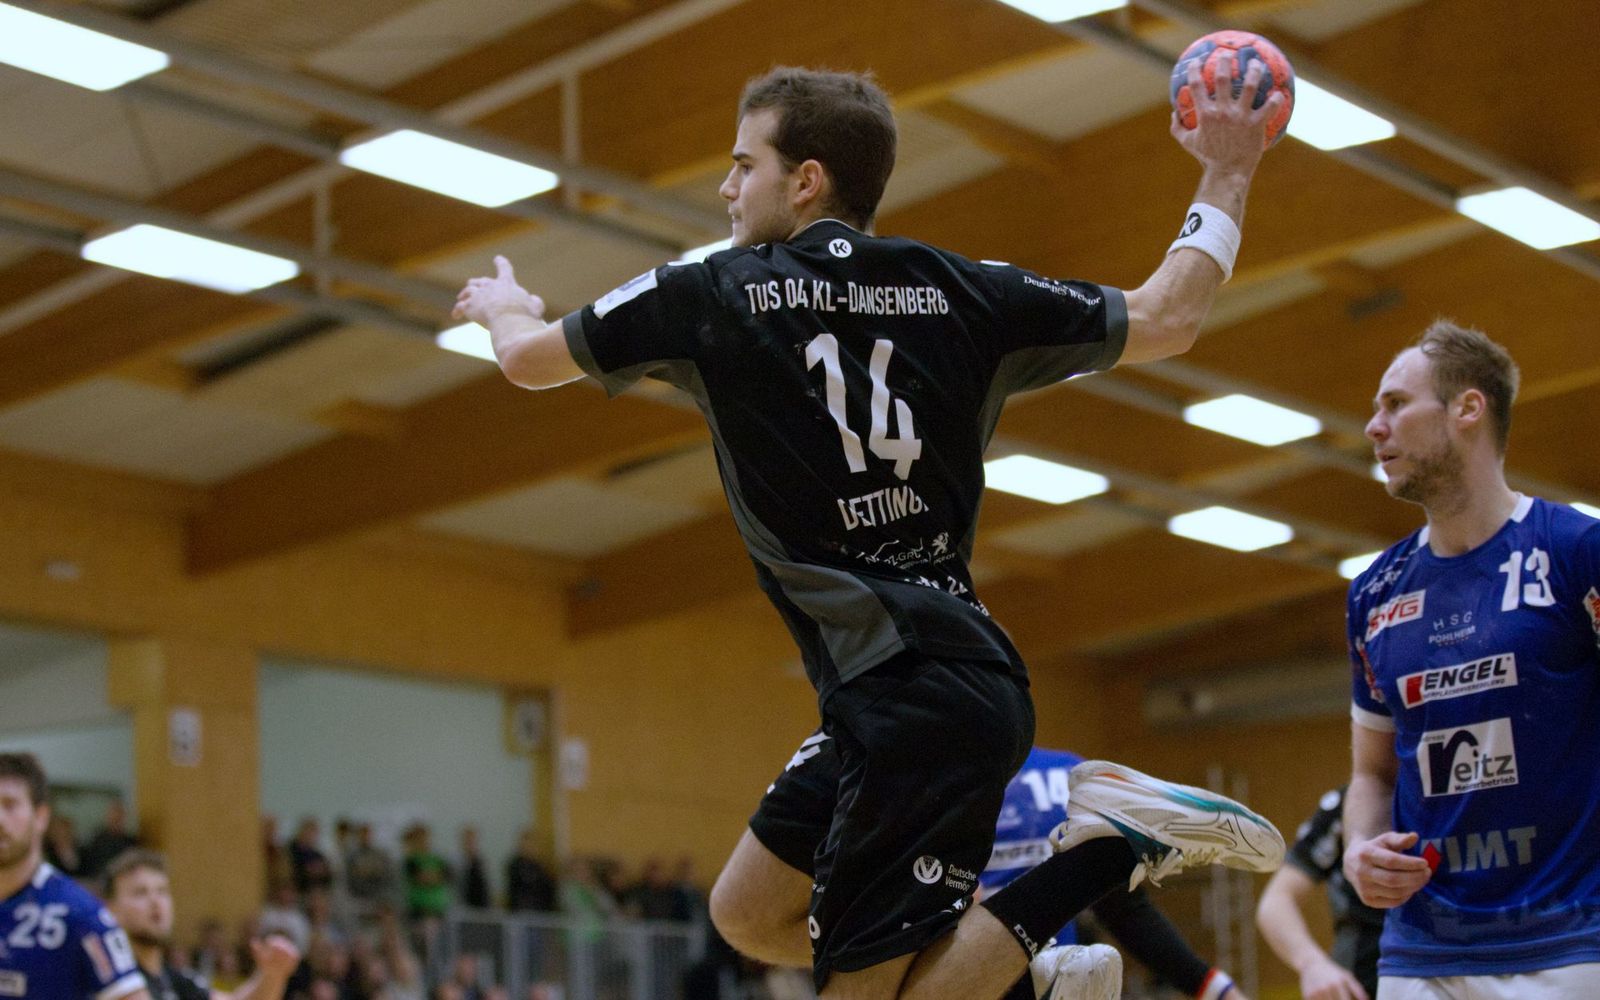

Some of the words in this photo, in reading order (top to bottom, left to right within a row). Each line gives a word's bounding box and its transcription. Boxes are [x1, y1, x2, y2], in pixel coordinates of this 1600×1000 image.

[785, 278, 809, 309] 04
[805, 333, 922, 480] 14
[1499, 547, 1556, 612] 13
[1424, 658, 1507, 691] ENGEL
[948, 864, 977, 881] Deutsche
[8, 903, 69, 950] 25
